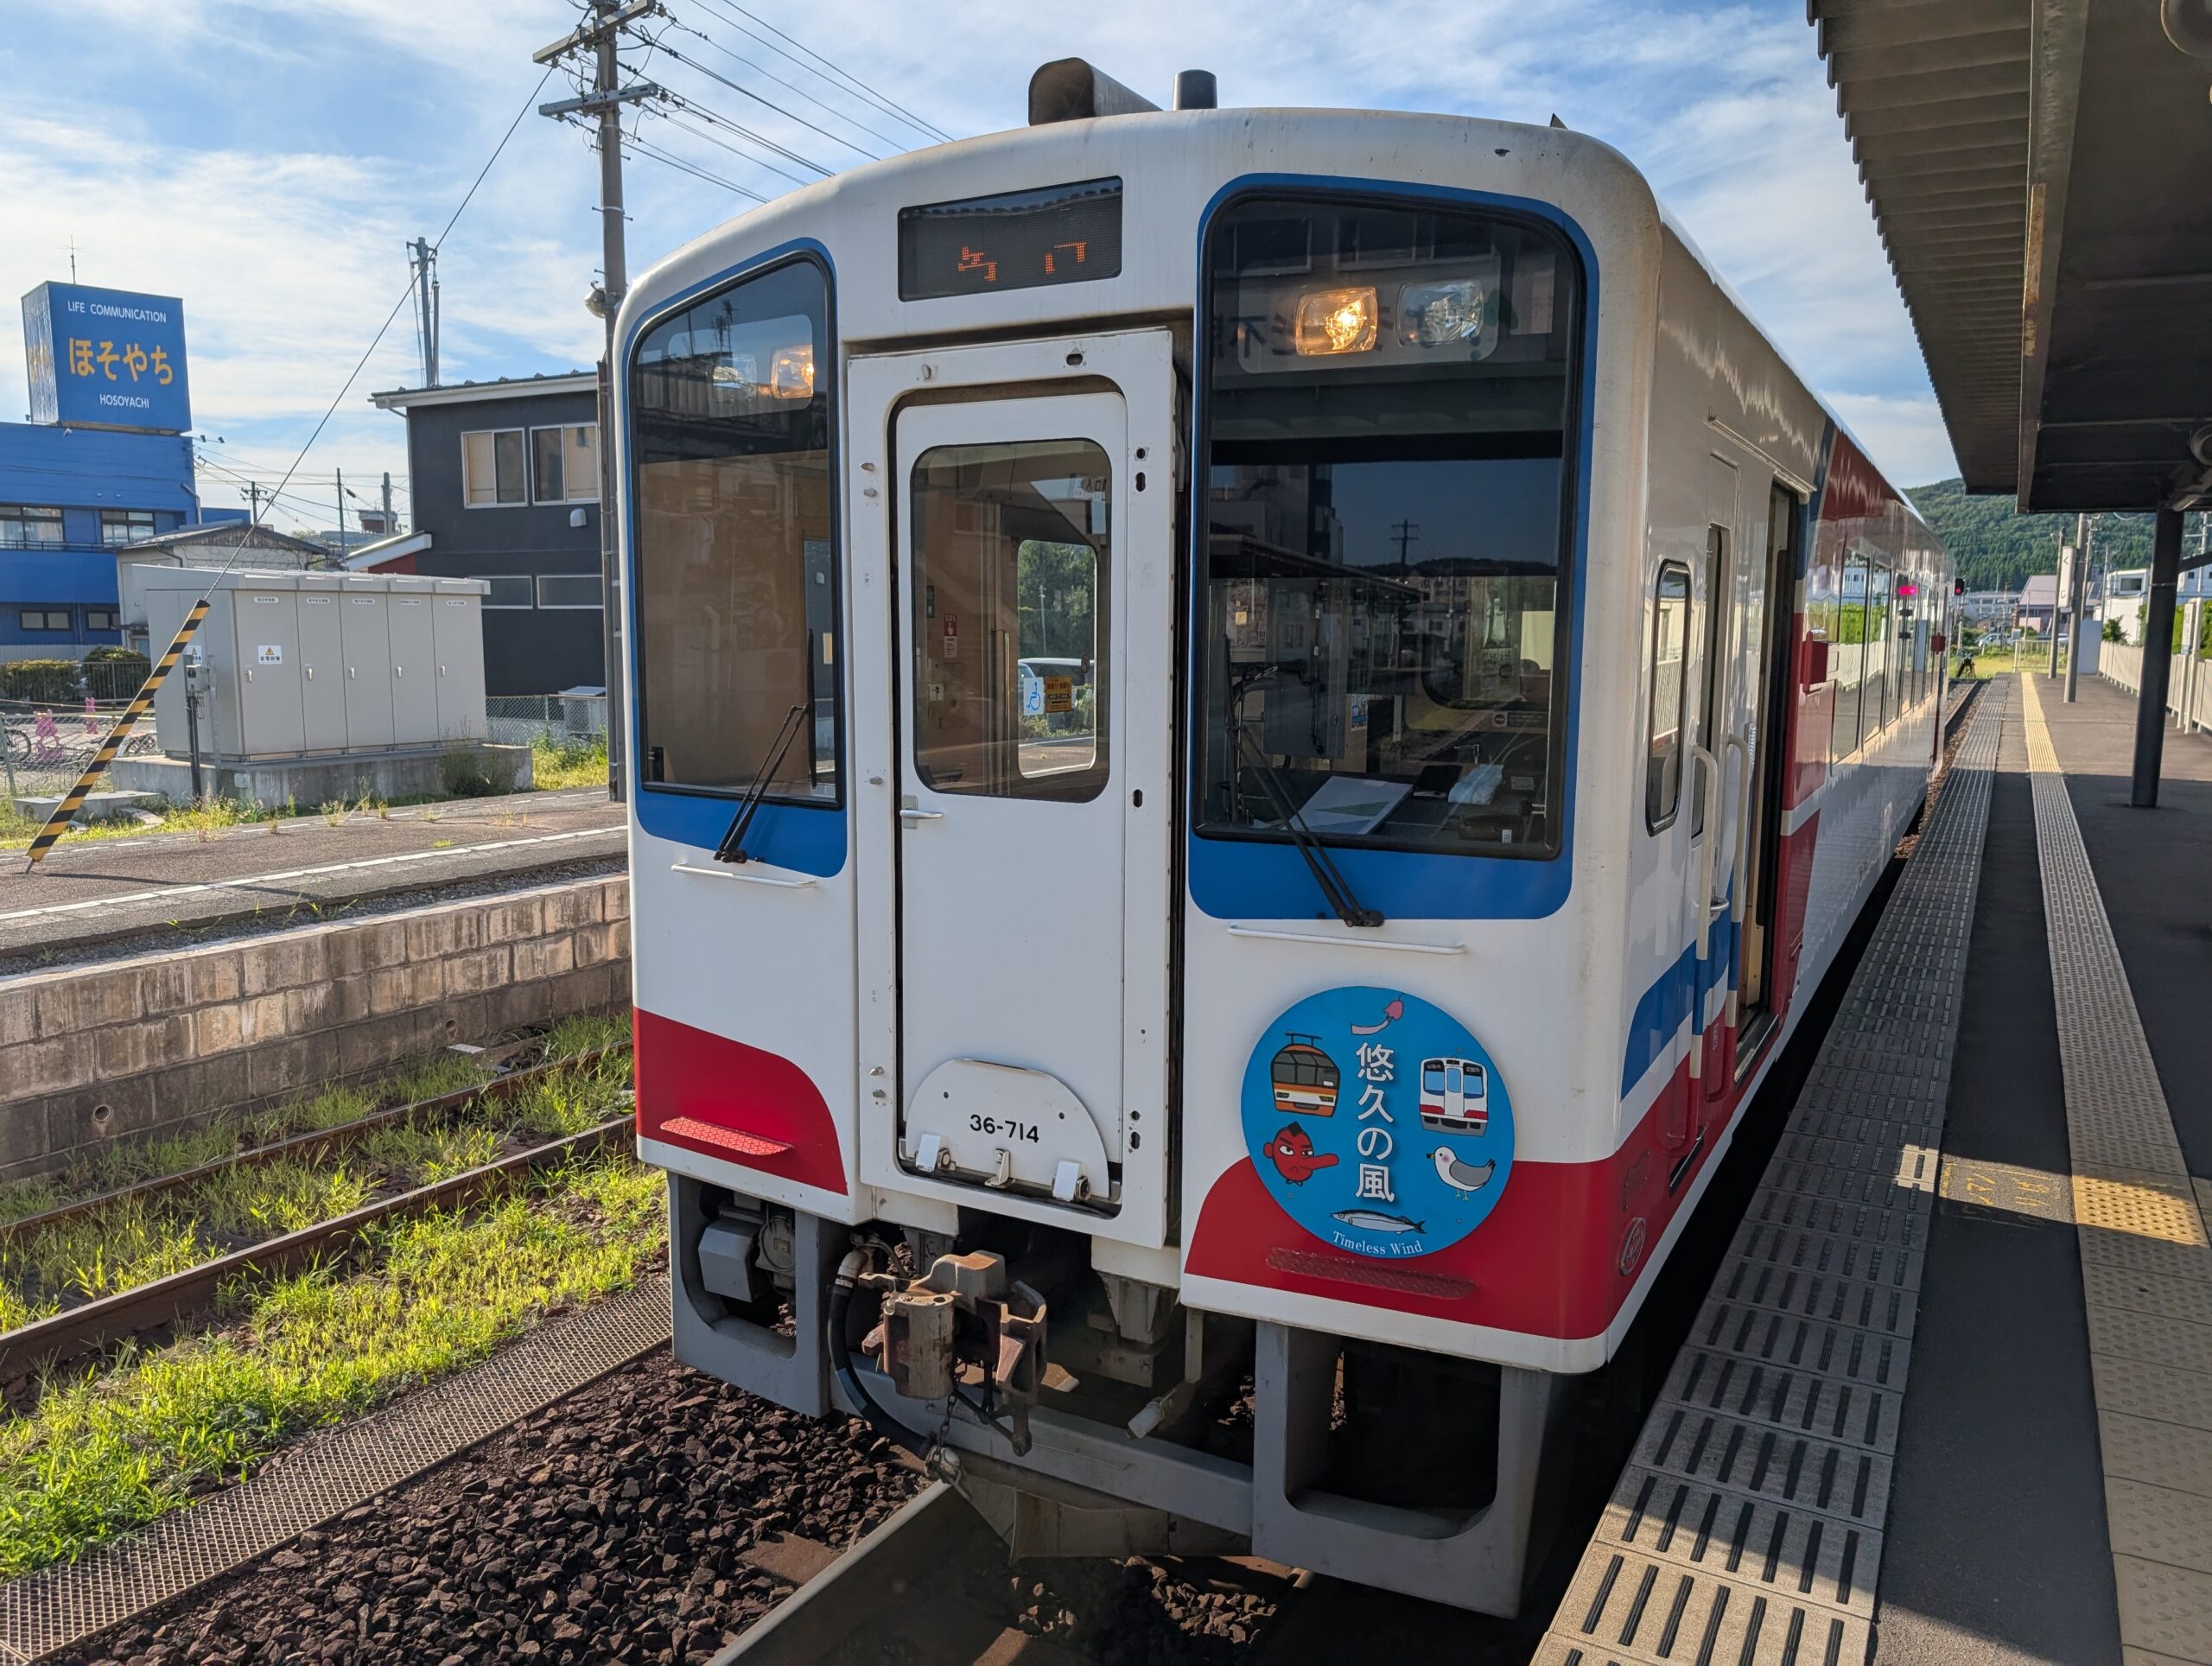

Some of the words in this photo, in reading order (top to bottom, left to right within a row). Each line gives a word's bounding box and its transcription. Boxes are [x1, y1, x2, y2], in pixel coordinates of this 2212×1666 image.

[67, 300, 86, 312] LIFE
[90, 303, 167, 323] COMMUNICATION
[68, 337, 174, 385] ほそやち
[99, 393, 149, 409] HOSOYACHI
[2060, 556, 2069, 599] くじ
[969, 1113, 1040, 1144] 36-714
[1354, 1041, 1395, 1203] 悠久の風
[1332, 1230, 1387, 1256] Timeless
[1390, 1239, 1424, 1256] Wind
